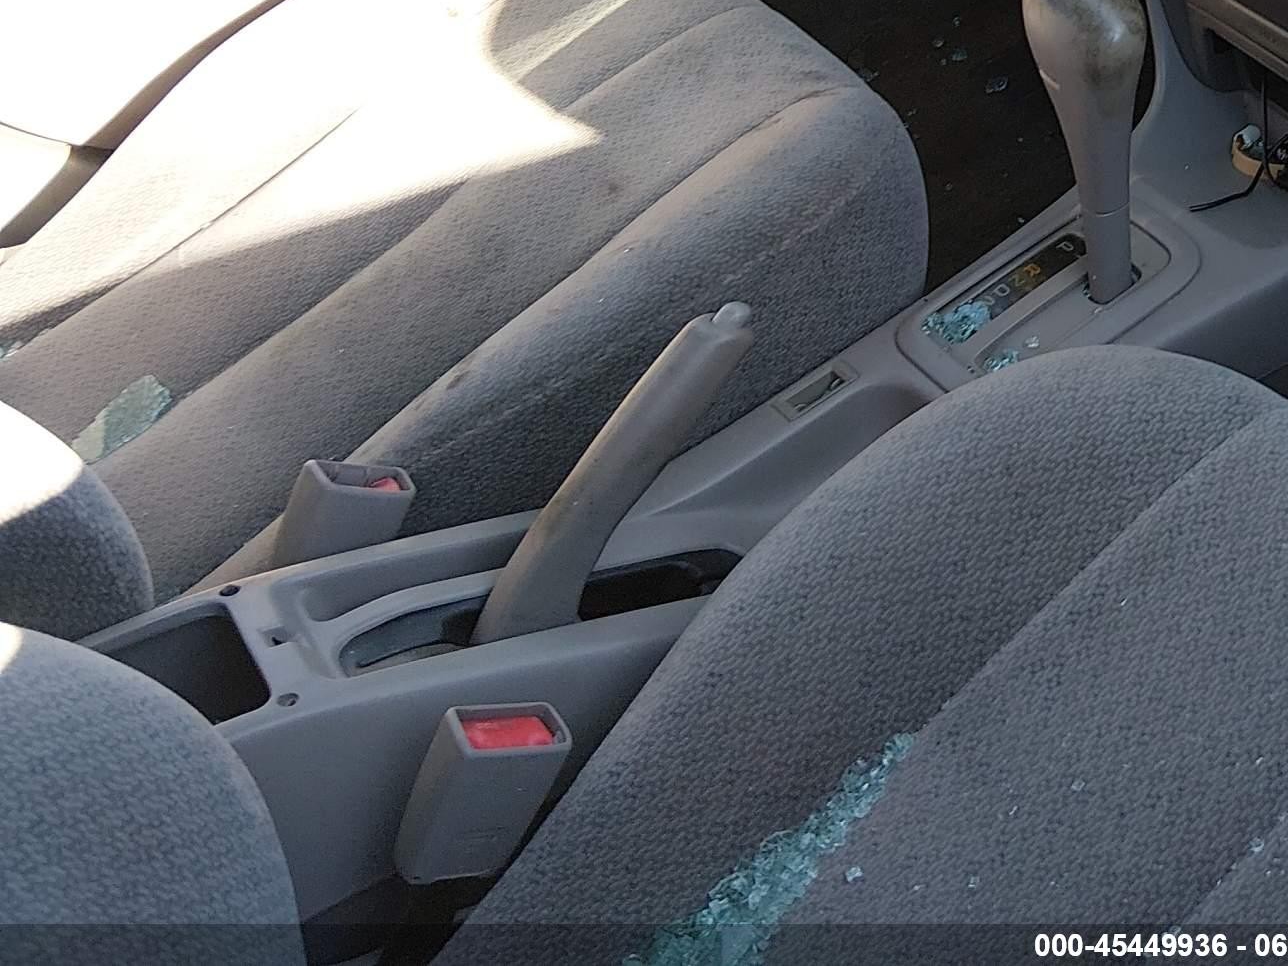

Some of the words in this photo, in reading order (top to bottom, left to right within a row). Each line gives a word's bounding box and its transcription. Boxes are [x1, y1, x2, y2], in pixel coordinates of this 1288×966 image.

[1057, 241, 1074, 251] P
[1025, 264, 1042, 277] R
[994, 284, 1010, 296] D
